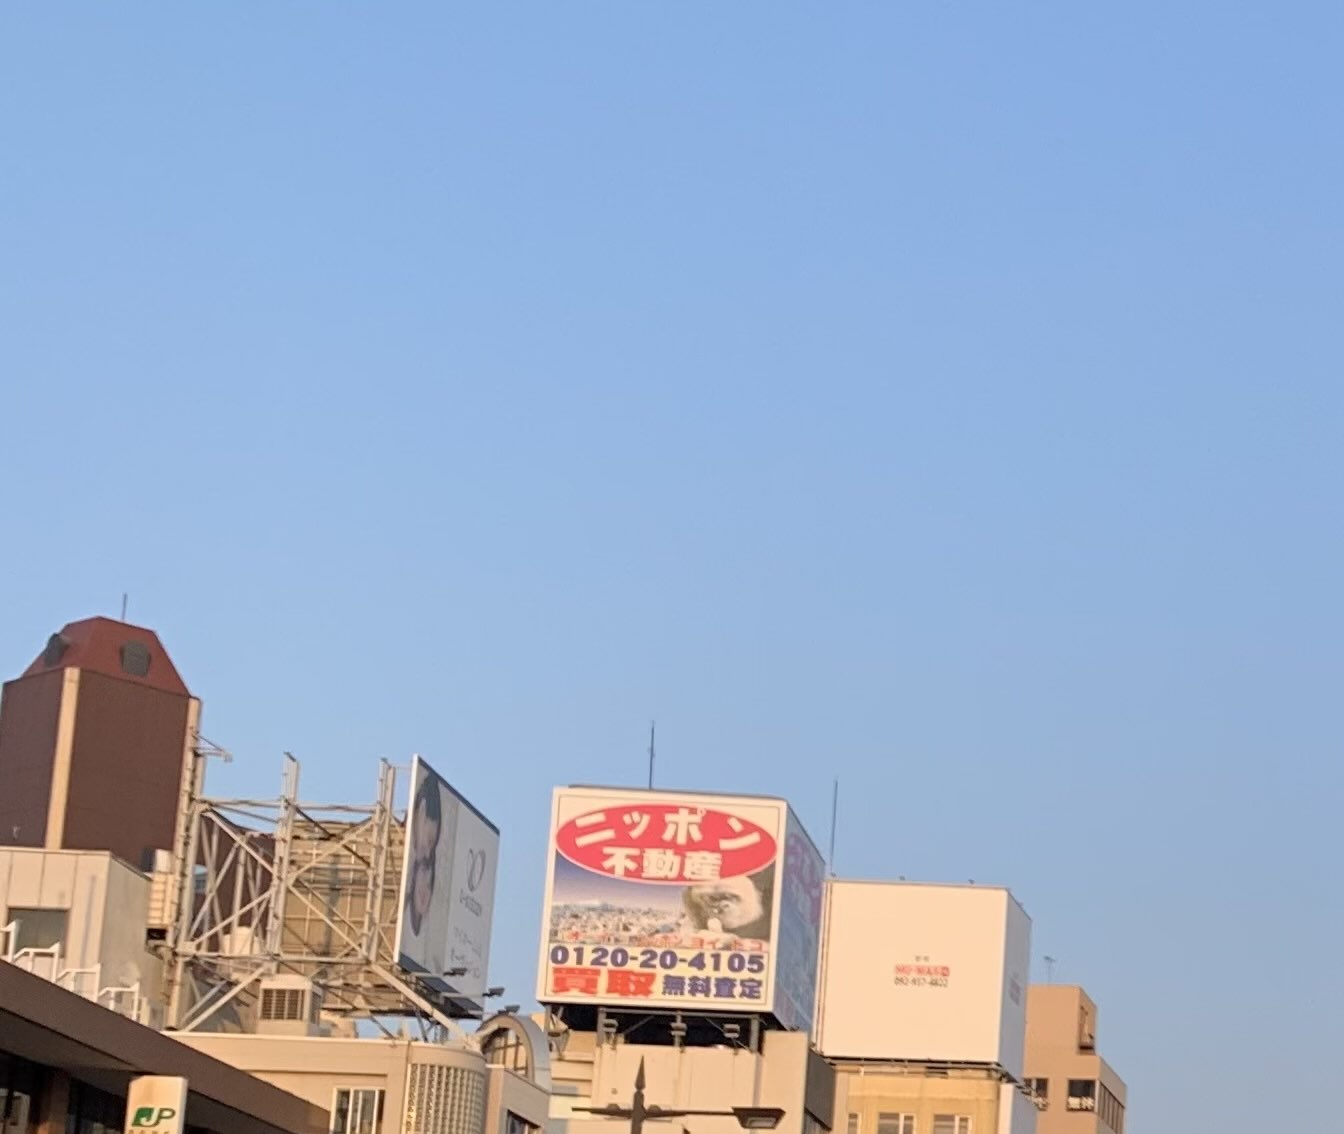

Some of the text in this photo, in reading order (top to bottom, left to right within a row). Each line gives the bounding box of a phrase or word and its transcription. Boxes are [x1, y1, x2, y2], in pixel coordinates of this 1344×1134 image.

[574, 807, 761, 852] ニッポン
[602, 847, 722, 881] 不動産
[550, 945, 764, 974] 0120-20-4105
[661, 974, 763, 999] 無料査定
